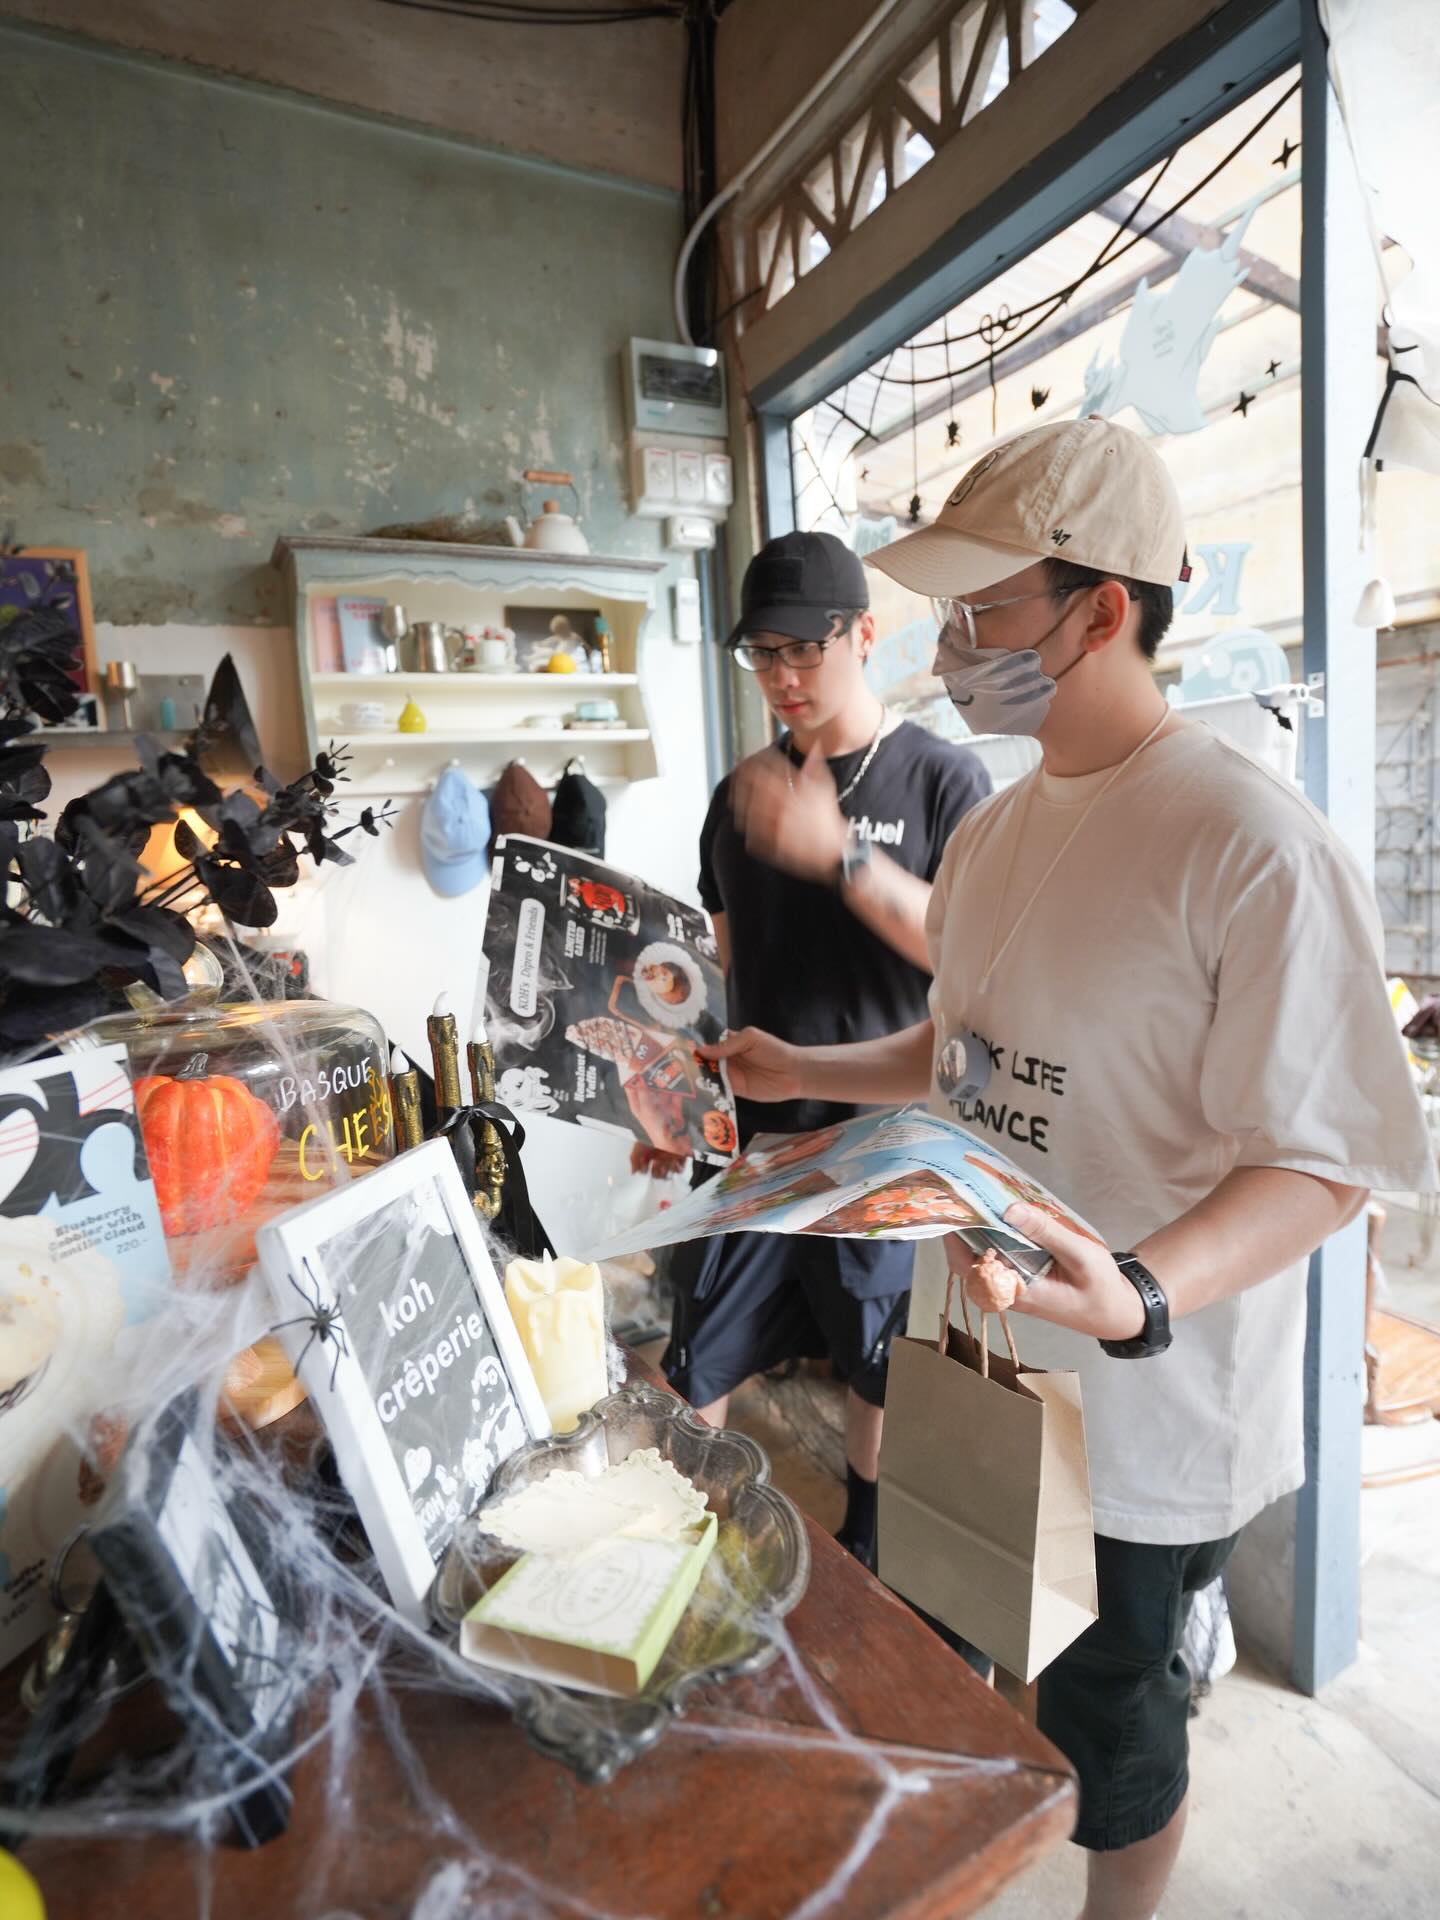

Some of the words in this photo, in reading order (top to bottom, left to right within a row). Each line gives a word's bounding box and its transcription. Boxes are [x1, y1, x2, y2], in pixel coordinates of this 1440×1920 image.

[279, 1056, 371, 1112] BASQUE
[1012, 1050, 1067, 1096] LIFE
[949, 1098, 1049, 1153] ALANCE
[48, 1225, 103, 1252] Cobbler
[106, 1212, 142, 1229] with
[48, 1238, 102, 1263] Vanilla
[104, 1220, 146, 1241] Cloud
[55, 1205, 131, 1237] Blueberry
[378, 1278, 435, 1337] koh
[377, 1312, 483, 1423] crêperie
